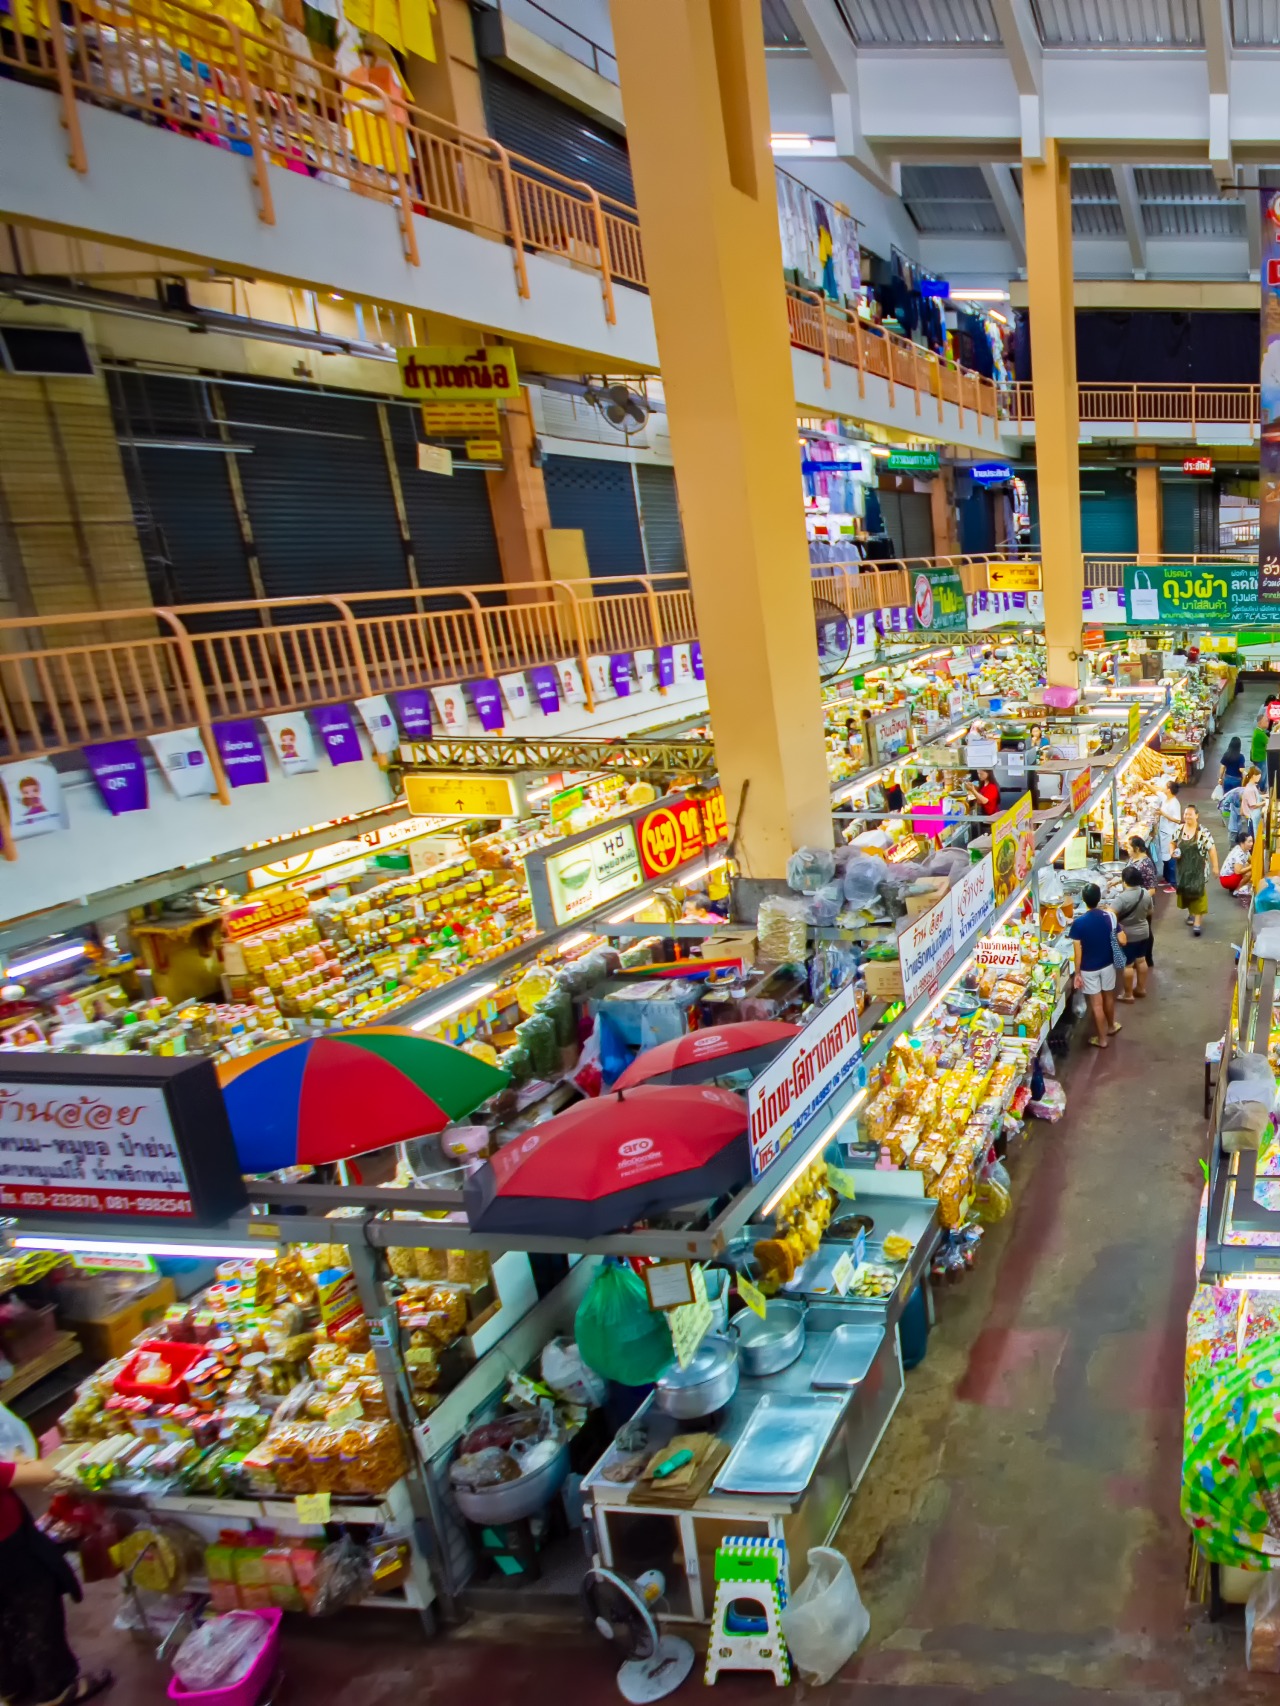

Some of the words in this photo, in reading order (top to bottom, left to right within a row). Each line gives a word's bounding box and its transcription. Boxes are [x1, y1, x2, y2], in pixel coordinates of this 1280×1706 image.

[1163, 573, 1227, 606] ถุงผ้า
[1182, 599, 1227, 611] มาใส่สินค้า
[1231, 612, 1243, 620] NO
[1244, 612, 1280, 623] PLASTIC
[328, 734, 345, 745] QR
[107, 776, 127, 790] QR
[647, 820, 675, 866] นุช
[0, 1088, 147, 1130] ้านอ้อย
[118, 1132, 177, 1158] ป้าย่น
[623, 1140, 649, 1154] aro
